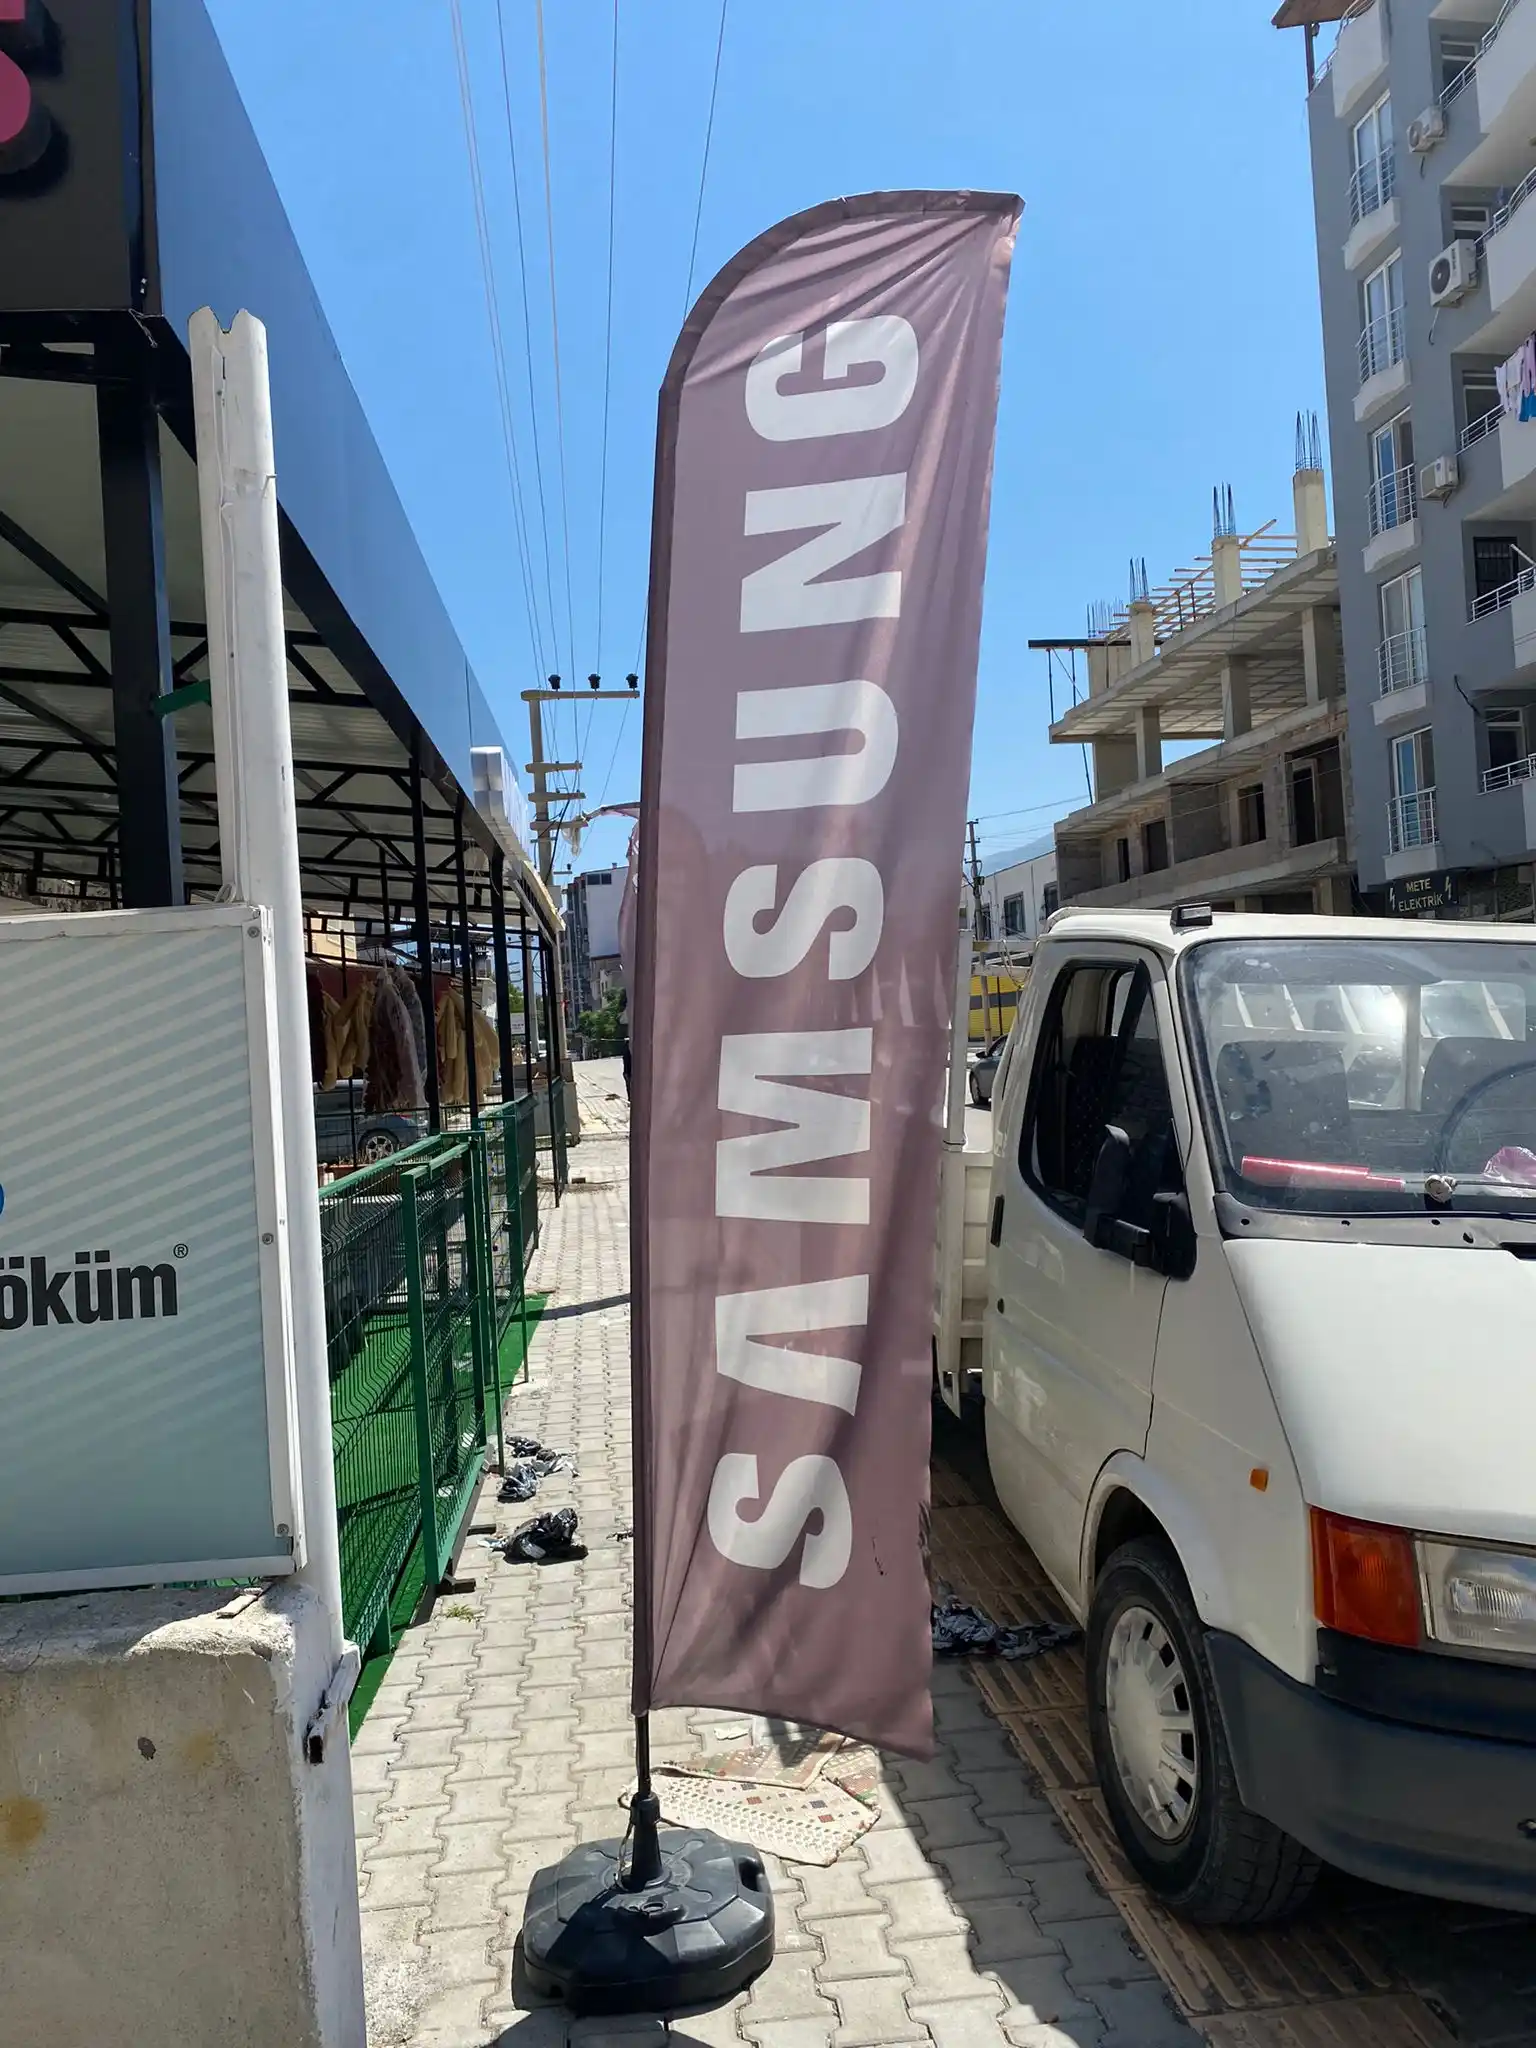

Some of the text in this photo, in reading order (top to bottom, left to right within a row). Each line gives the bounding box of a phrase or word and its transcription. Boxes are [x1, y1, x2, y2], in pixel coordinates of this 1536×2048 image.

[1406, 878, 1432, 893] METE
[1399, 892, 1444, 912] ELEKTRİK
[707, 314, 919, 1589] SAMSUNG
